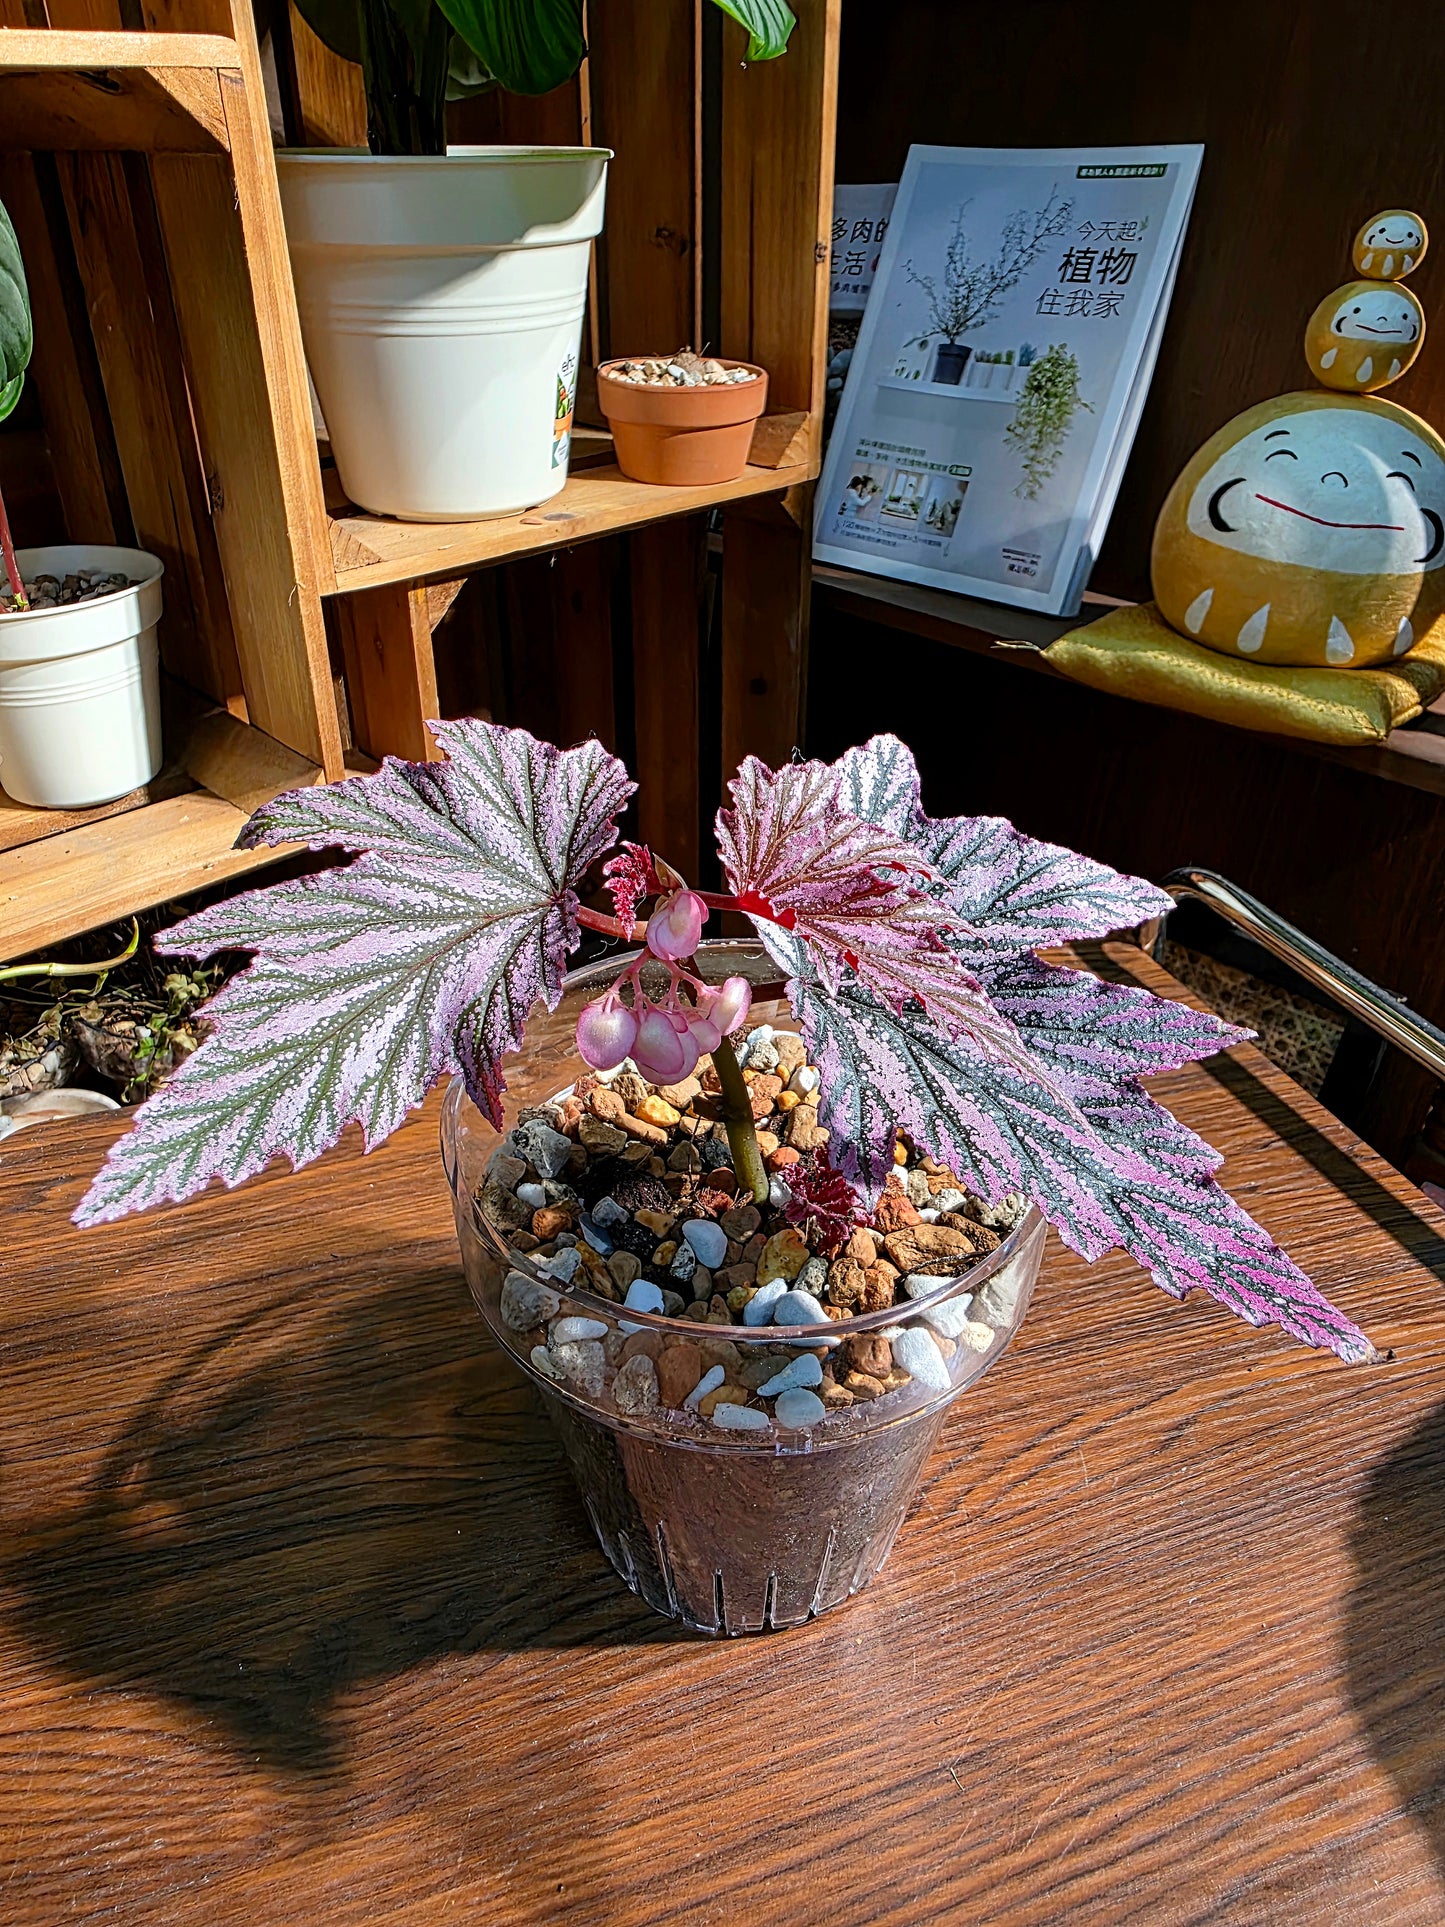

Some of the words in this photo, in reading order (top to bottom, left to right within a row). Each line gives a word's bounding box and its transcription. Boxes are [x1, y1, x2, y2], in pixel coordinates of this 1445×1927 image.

[1058, 246, 1138, 284] 植物
[1035, 288, 1126, 319] 住我家
